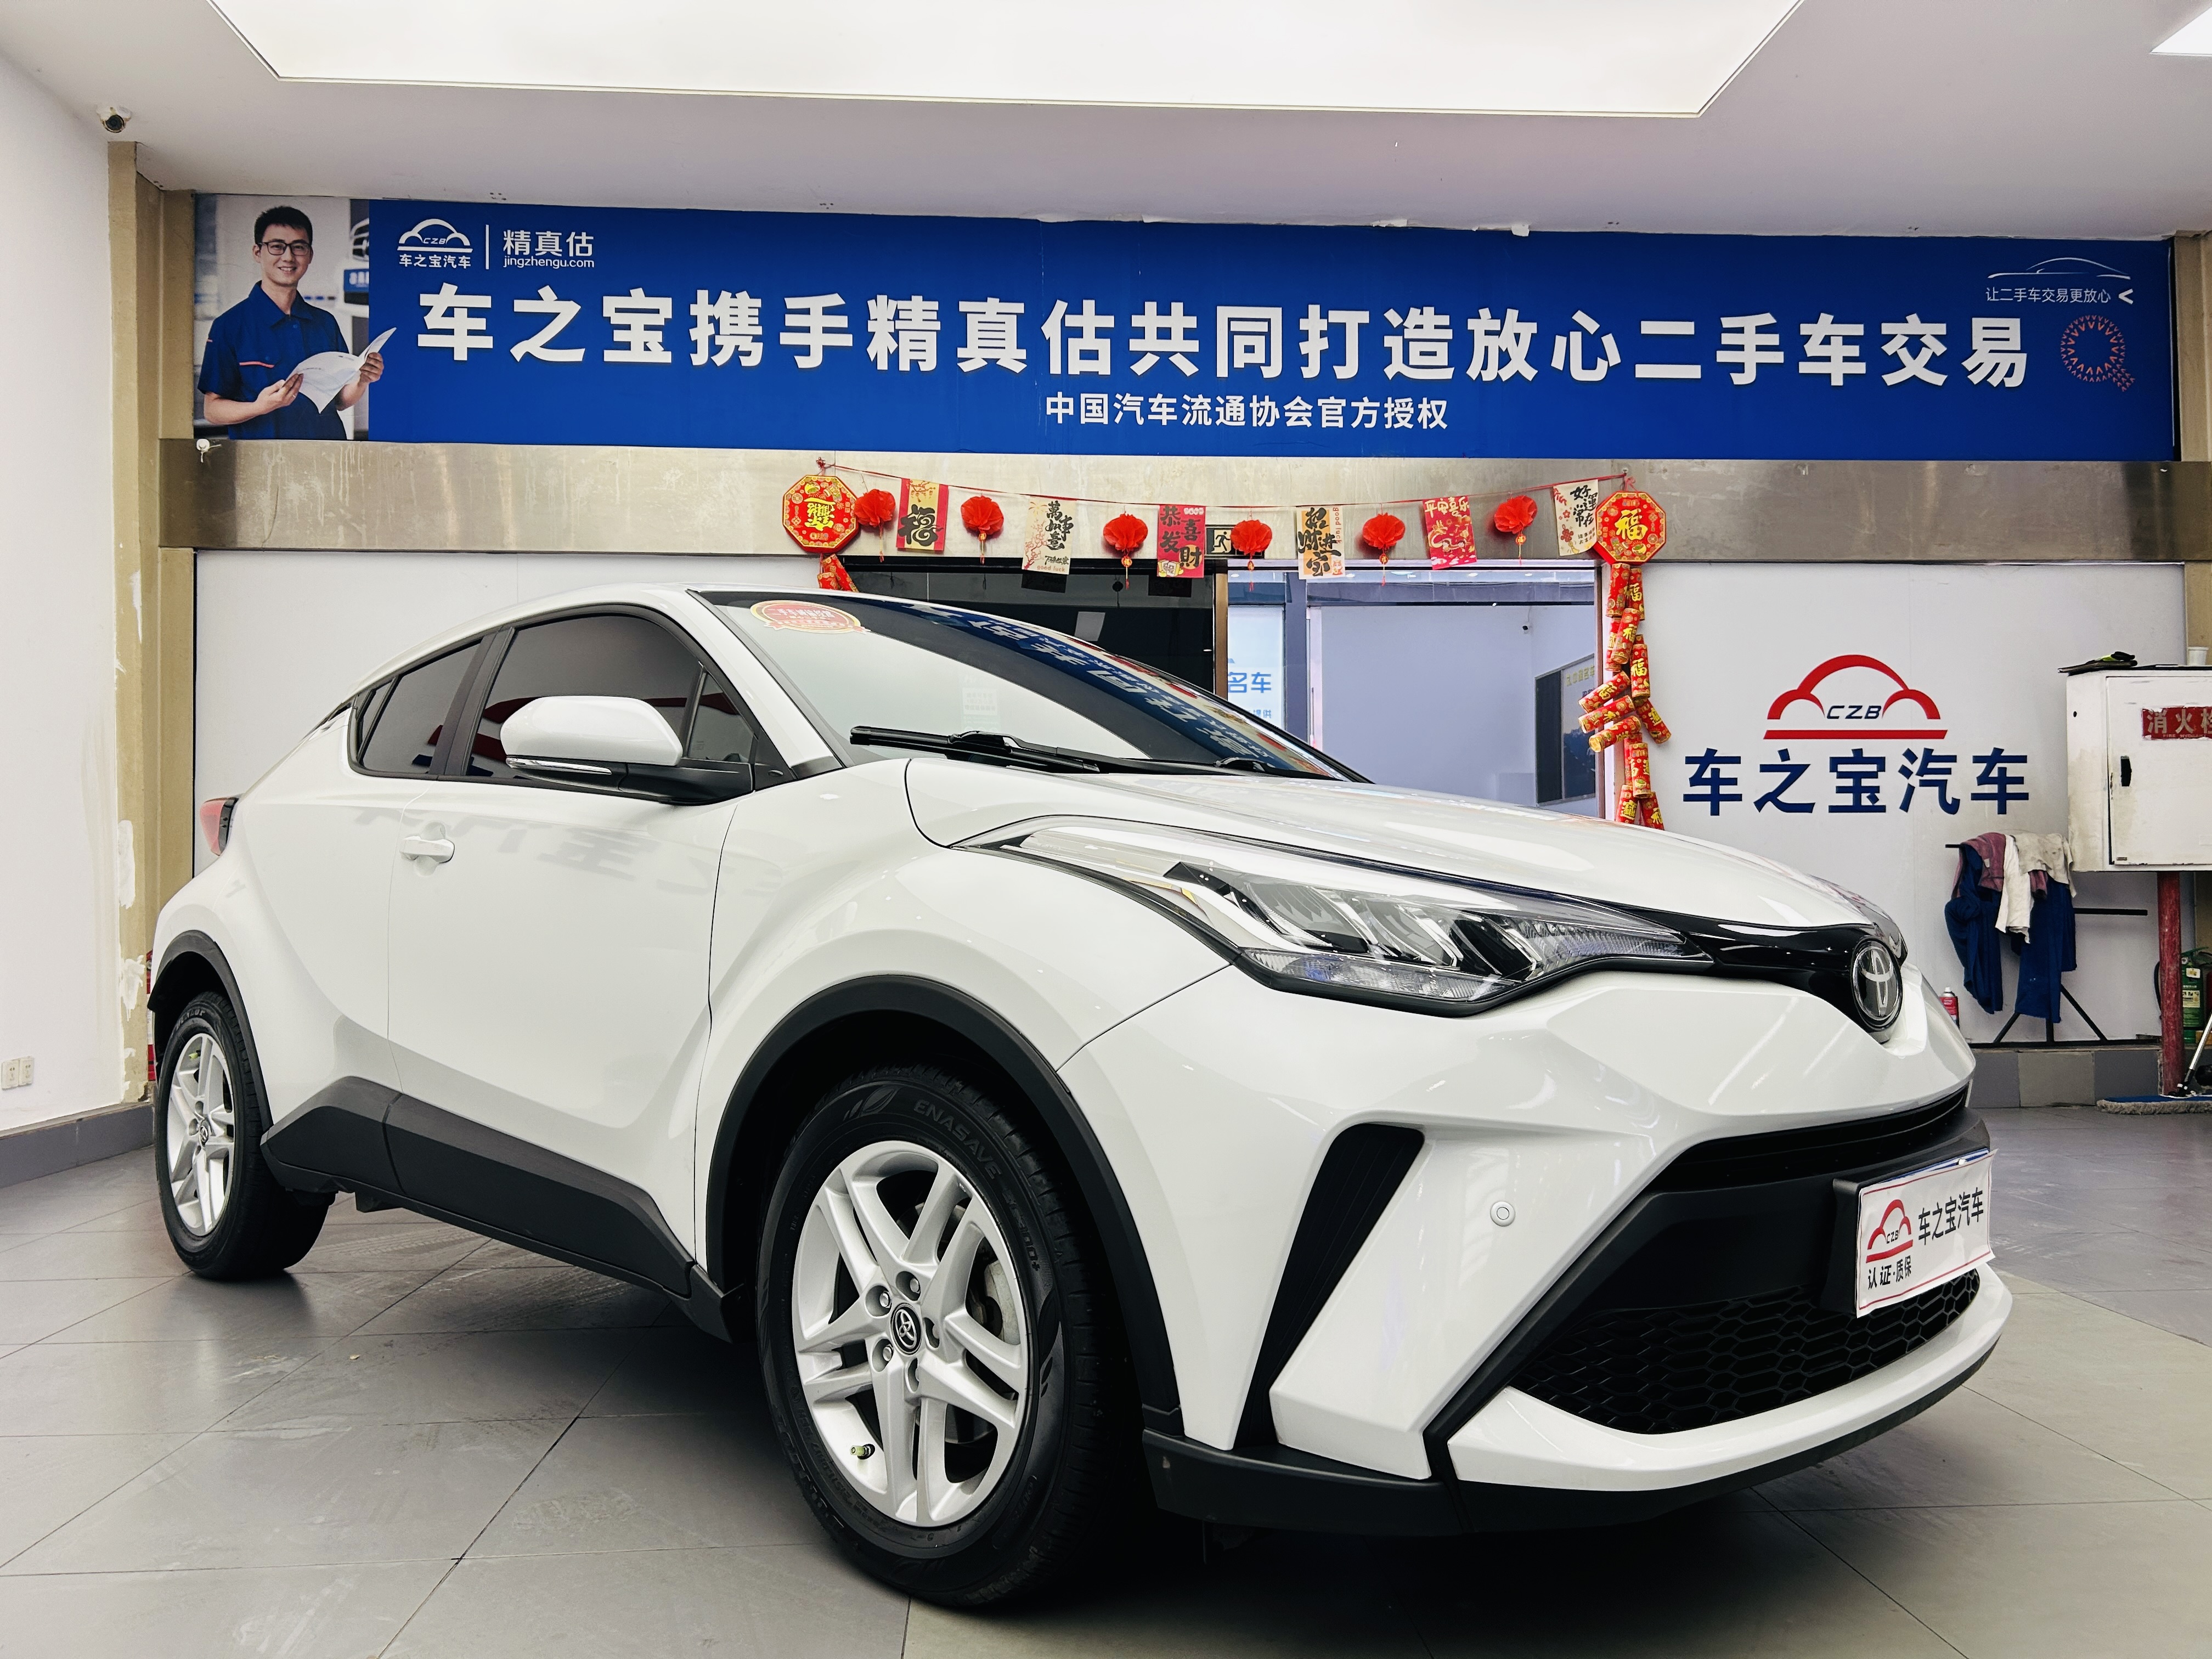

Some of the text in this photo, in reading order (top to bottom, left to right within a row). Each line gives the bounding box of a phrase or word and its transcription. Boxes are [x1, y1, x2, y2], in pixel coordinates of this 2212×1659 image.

[503, 230, 594, 257] 精真估
[399, 253, 471, 269] 车之宝汽车
[503, 256, 595, 269] jingzhengu.com
[1985, 287, 2112, 303] 让二手车交易更放心
[418, 283, 2027, 387] 车之宝携手精真估共同打造放心二手车交易
[1045, 392, 1448, 430] 中国汽车流通协会官方授权
[1615, 508, 1649, 541] 福
[1631, 658, 1648, 677] 福
[1826, 705, 1882, 719] CZB
[1682, 747, 2029, 816] 车之宝汽车
[913, 1098, 1003, 1180] ENASAVE
[1917, 1187, 1984, 1246] 车之宝汽车
